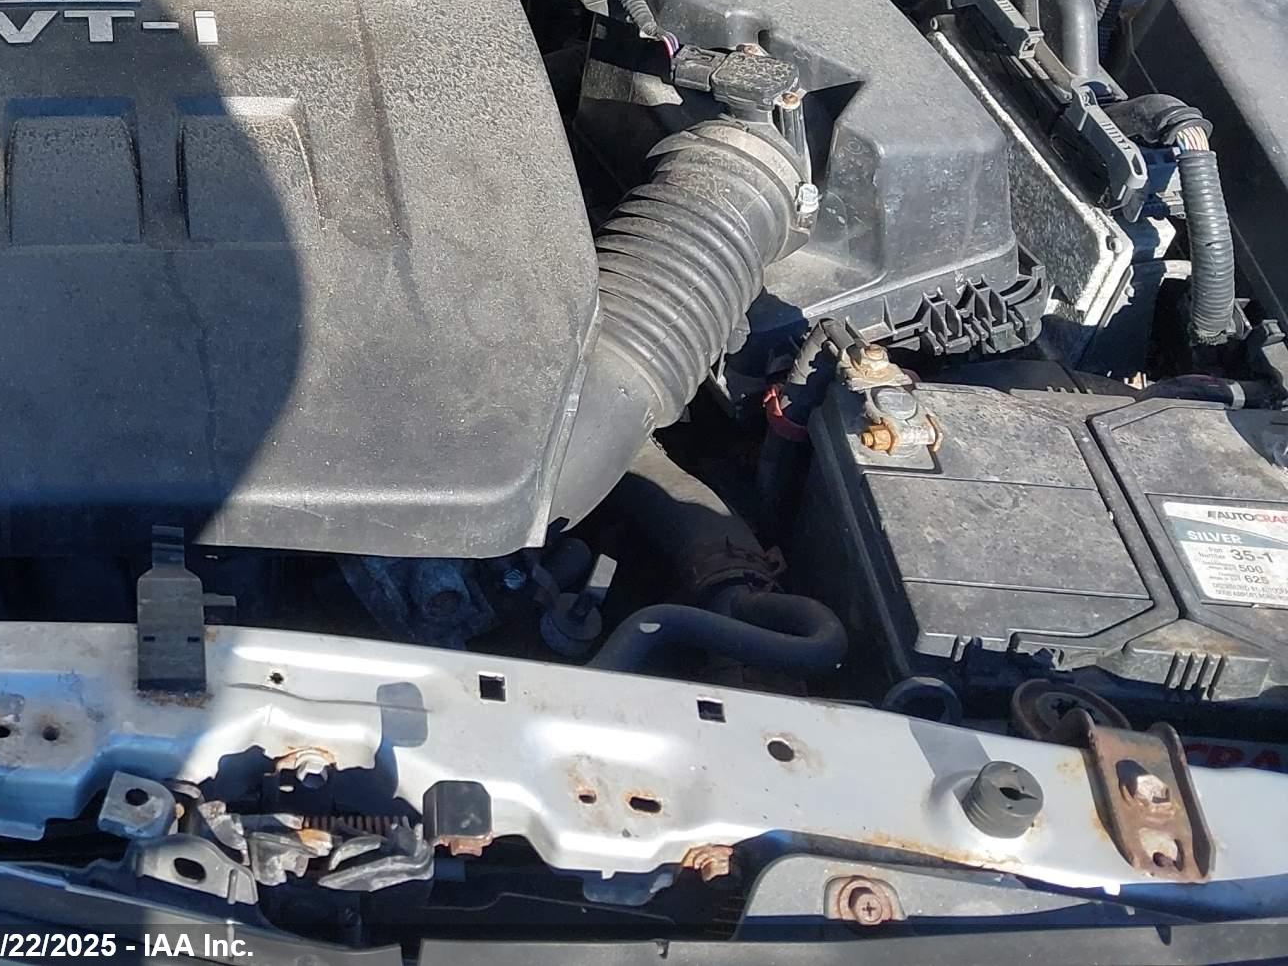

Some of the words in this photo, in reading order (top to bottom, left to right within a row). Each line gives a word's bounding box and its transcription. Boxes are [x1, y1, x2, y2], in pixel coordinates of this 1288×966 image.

[1186, 530, 1243, 544] SILVER
[1230, 548, 1274, 563] 35-1
[1238, 564, 1264, 574] 500
[1244, 574, 1270, 585] 625
